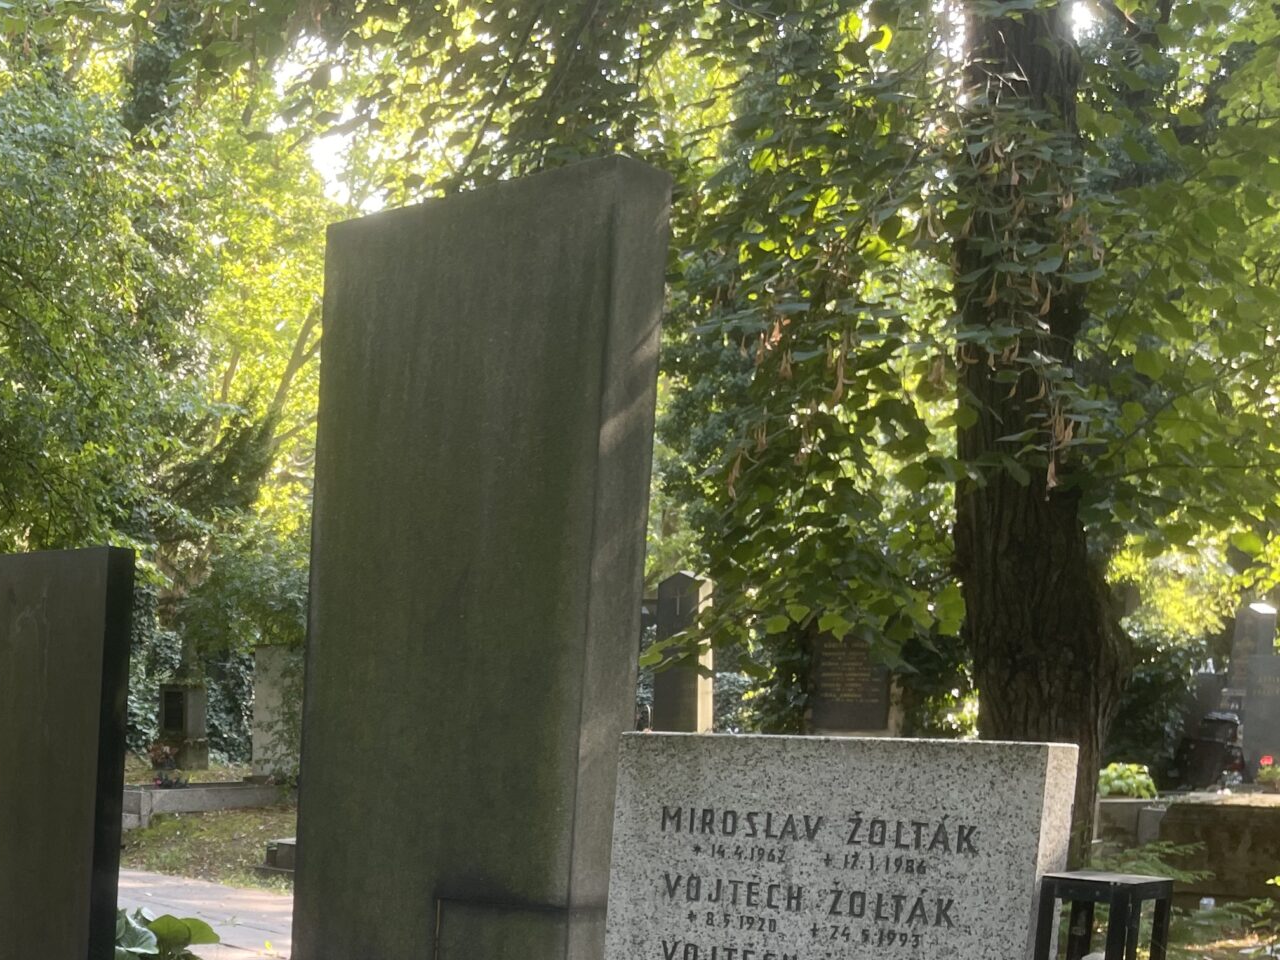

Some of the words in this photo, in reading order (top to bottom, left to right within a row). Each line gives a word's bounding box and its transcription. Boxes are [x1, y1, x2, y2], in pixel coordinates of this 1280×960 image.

[660, 805, 823, 842] MIROSLAV
[846, 810, 979, 855] ŽOLTÁK
[664, 872, 804, 912] VOJTĚCH
[828, 880, 956, 929] ŽOLTÁK
